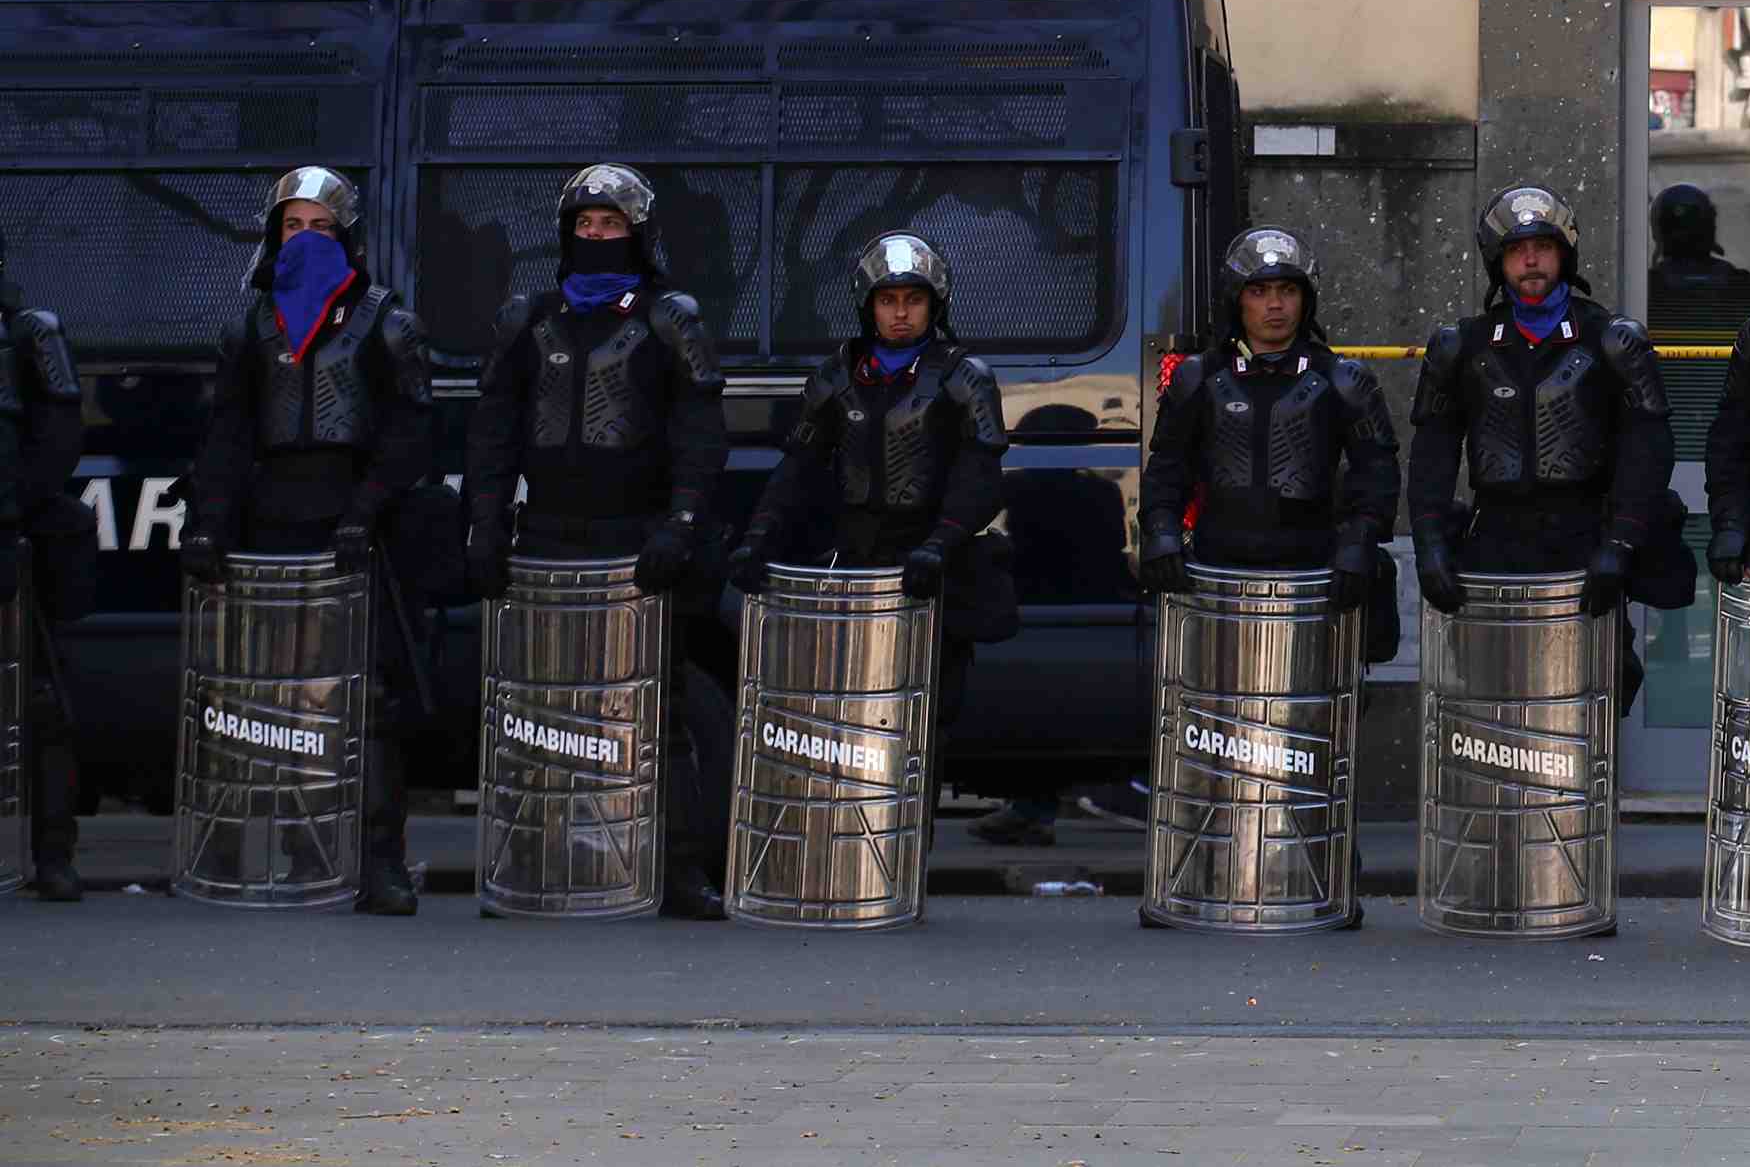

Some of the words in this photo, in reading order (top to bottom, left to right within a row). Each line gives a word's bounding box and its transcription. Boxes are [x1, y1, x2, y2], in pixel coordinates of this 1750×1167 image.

[203, 705, 325, 757] CARABINIERI
[502, 712, 619, 764] CARABINIERI
[762, 721, 887, 772] CARABINIERI
[1184, 723, 1315, 776] CARABINIERI
[1451, 731, 1575, 779] CARABINIERI
